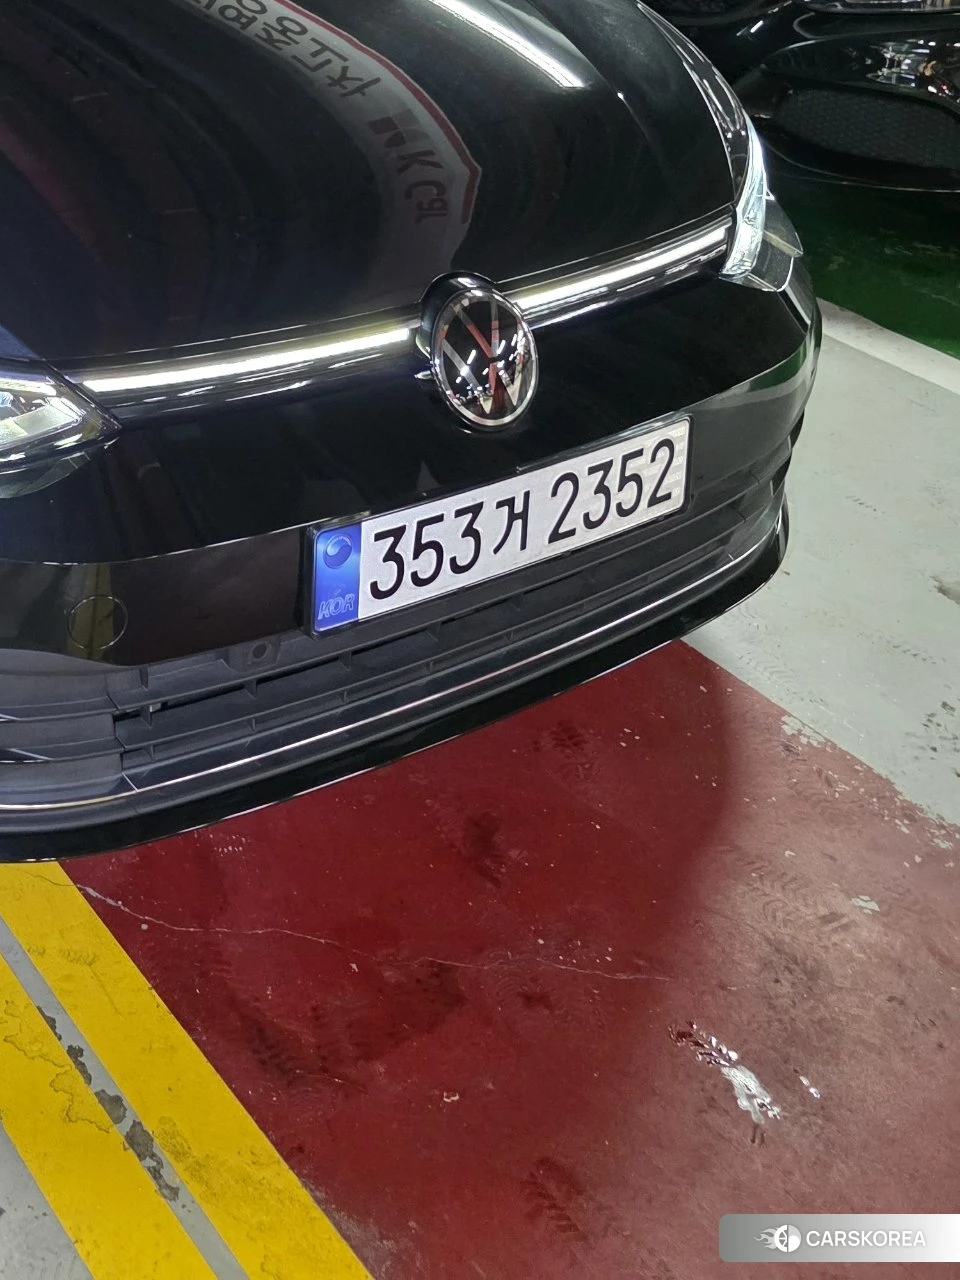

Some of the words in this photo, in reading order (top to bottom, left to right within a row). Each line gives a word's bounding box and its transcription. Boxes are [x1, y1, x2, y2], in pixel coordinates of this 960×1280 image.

[369, 489, 531, 600] 353거
[548, 438, 675, 544] 2352
[317, 593, 356, 620] KOR
